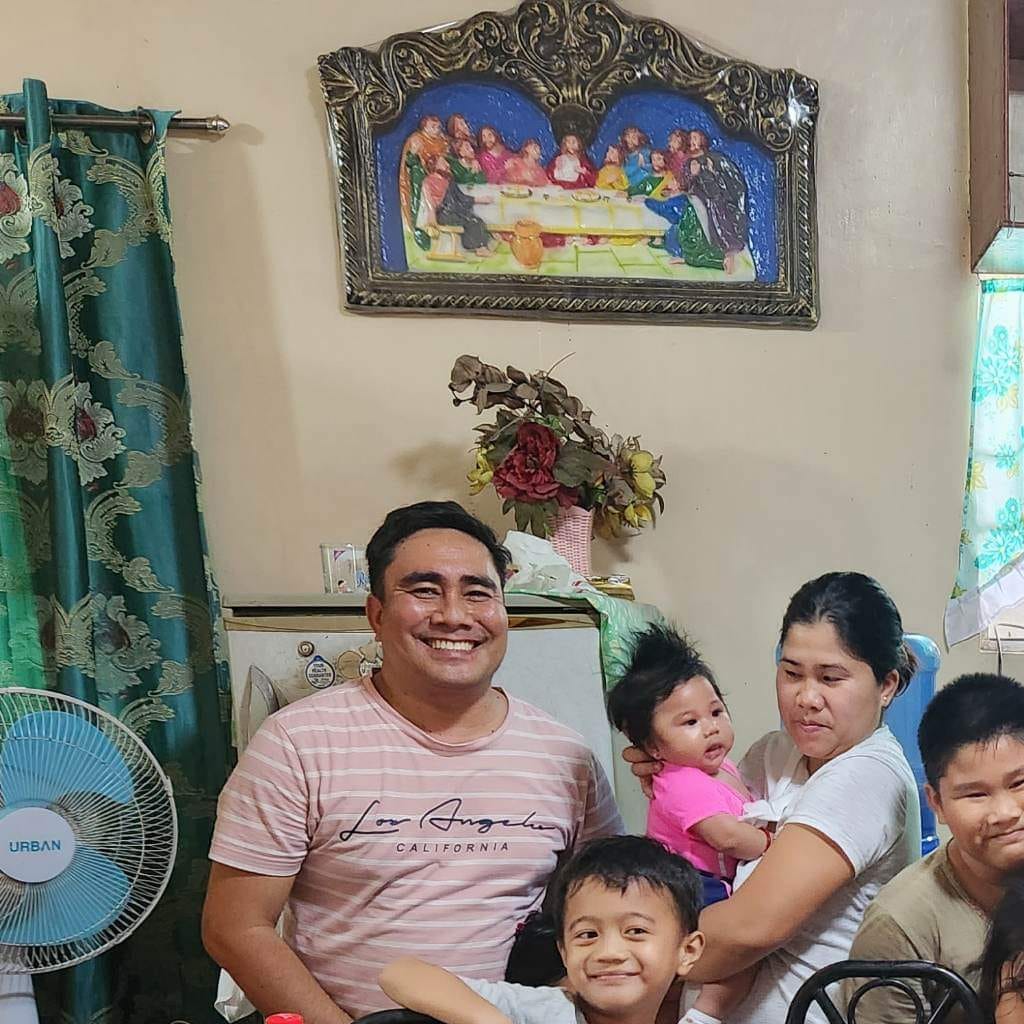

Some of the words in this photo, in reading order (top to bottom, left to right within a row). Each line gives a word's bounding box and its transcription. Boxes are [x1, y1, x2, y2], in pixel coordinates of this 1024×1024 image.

[339, 799, 411, 842] Los
[9, 840, 61, 852] URBAN
[396, 842, 510, 853] CALIFORNIA
